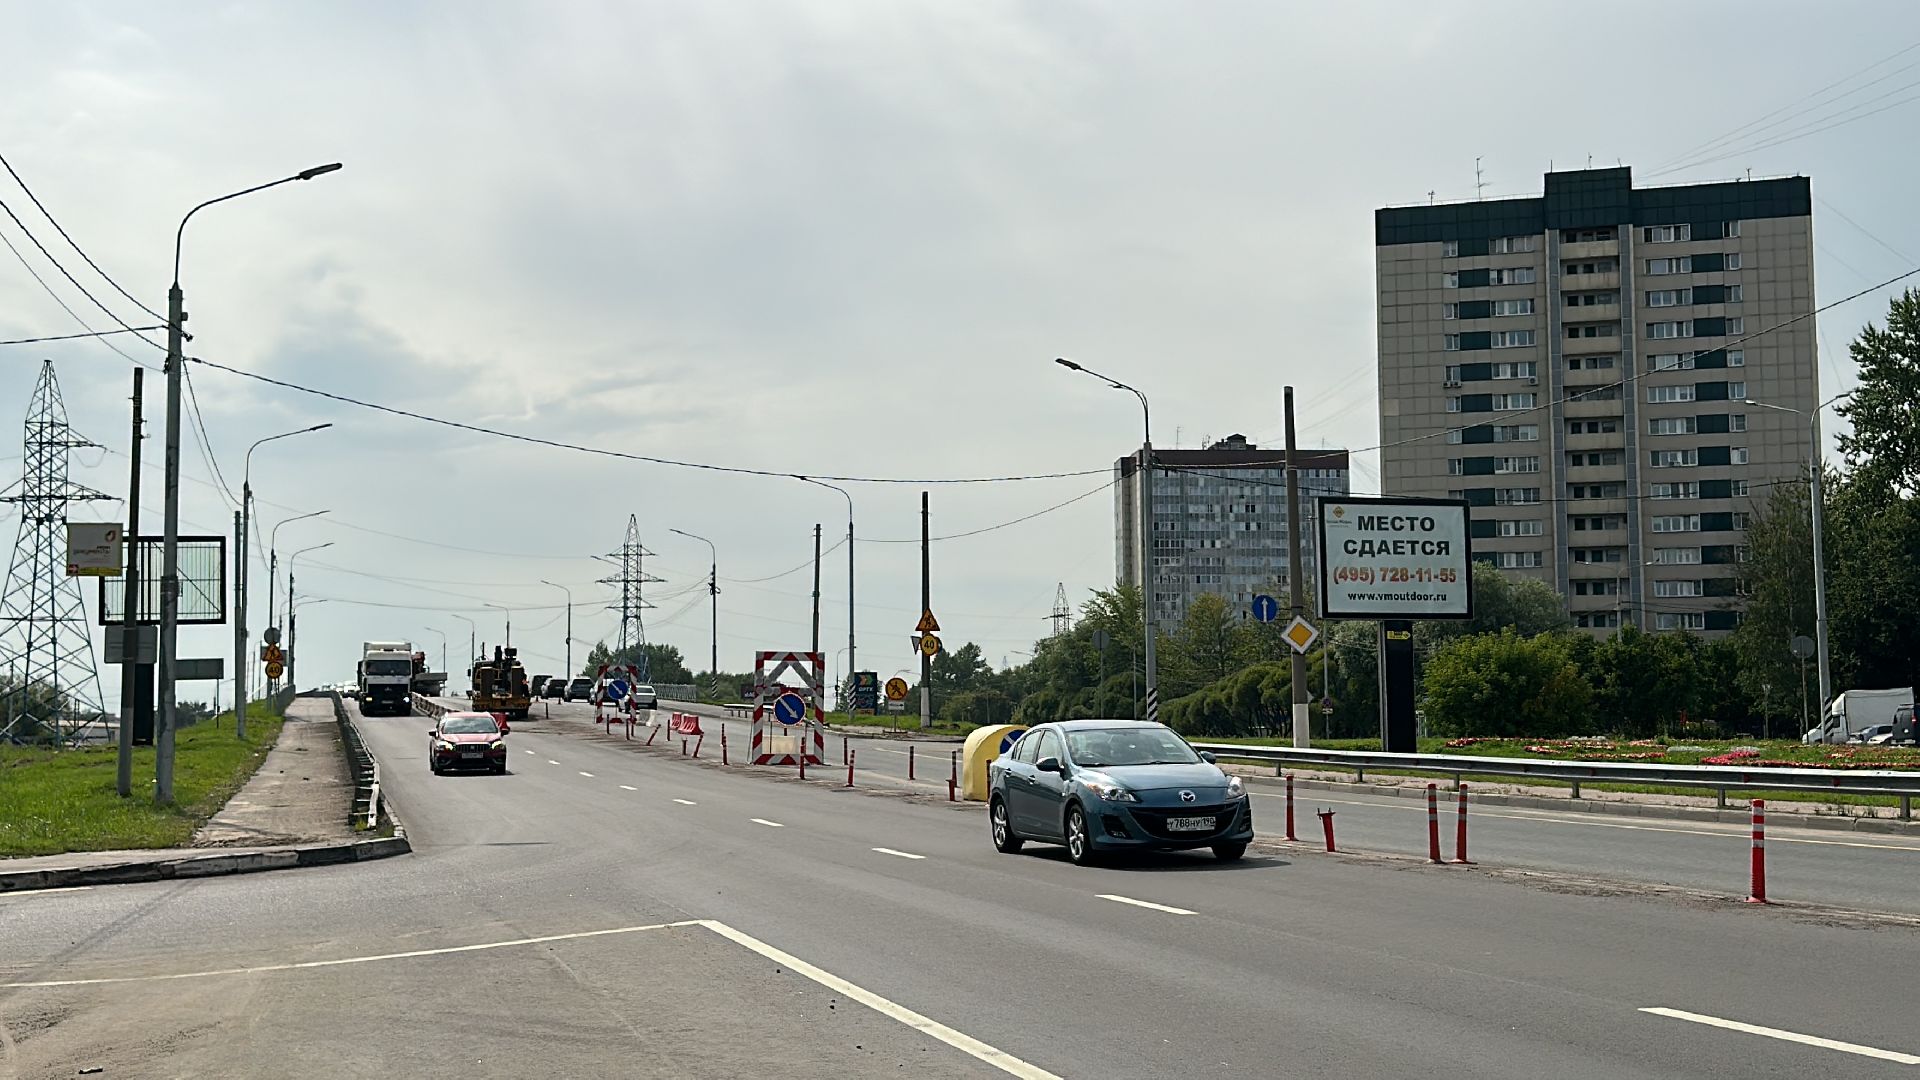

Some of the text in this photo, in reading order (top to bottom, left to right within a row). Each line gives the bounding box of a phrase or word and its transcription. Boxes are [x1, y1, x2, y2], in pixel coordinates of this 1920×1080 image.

[1357, 516, 1435, 531] МЕСТО
[1343, 539, 1449, 557] СДАЕТСЯ
[1333, 566, 1457, 585] (495) 728-11-55
[1348, 591, 1447, 601] www.vmoutdoor.ru
[924, 641, 934, 649] 40
